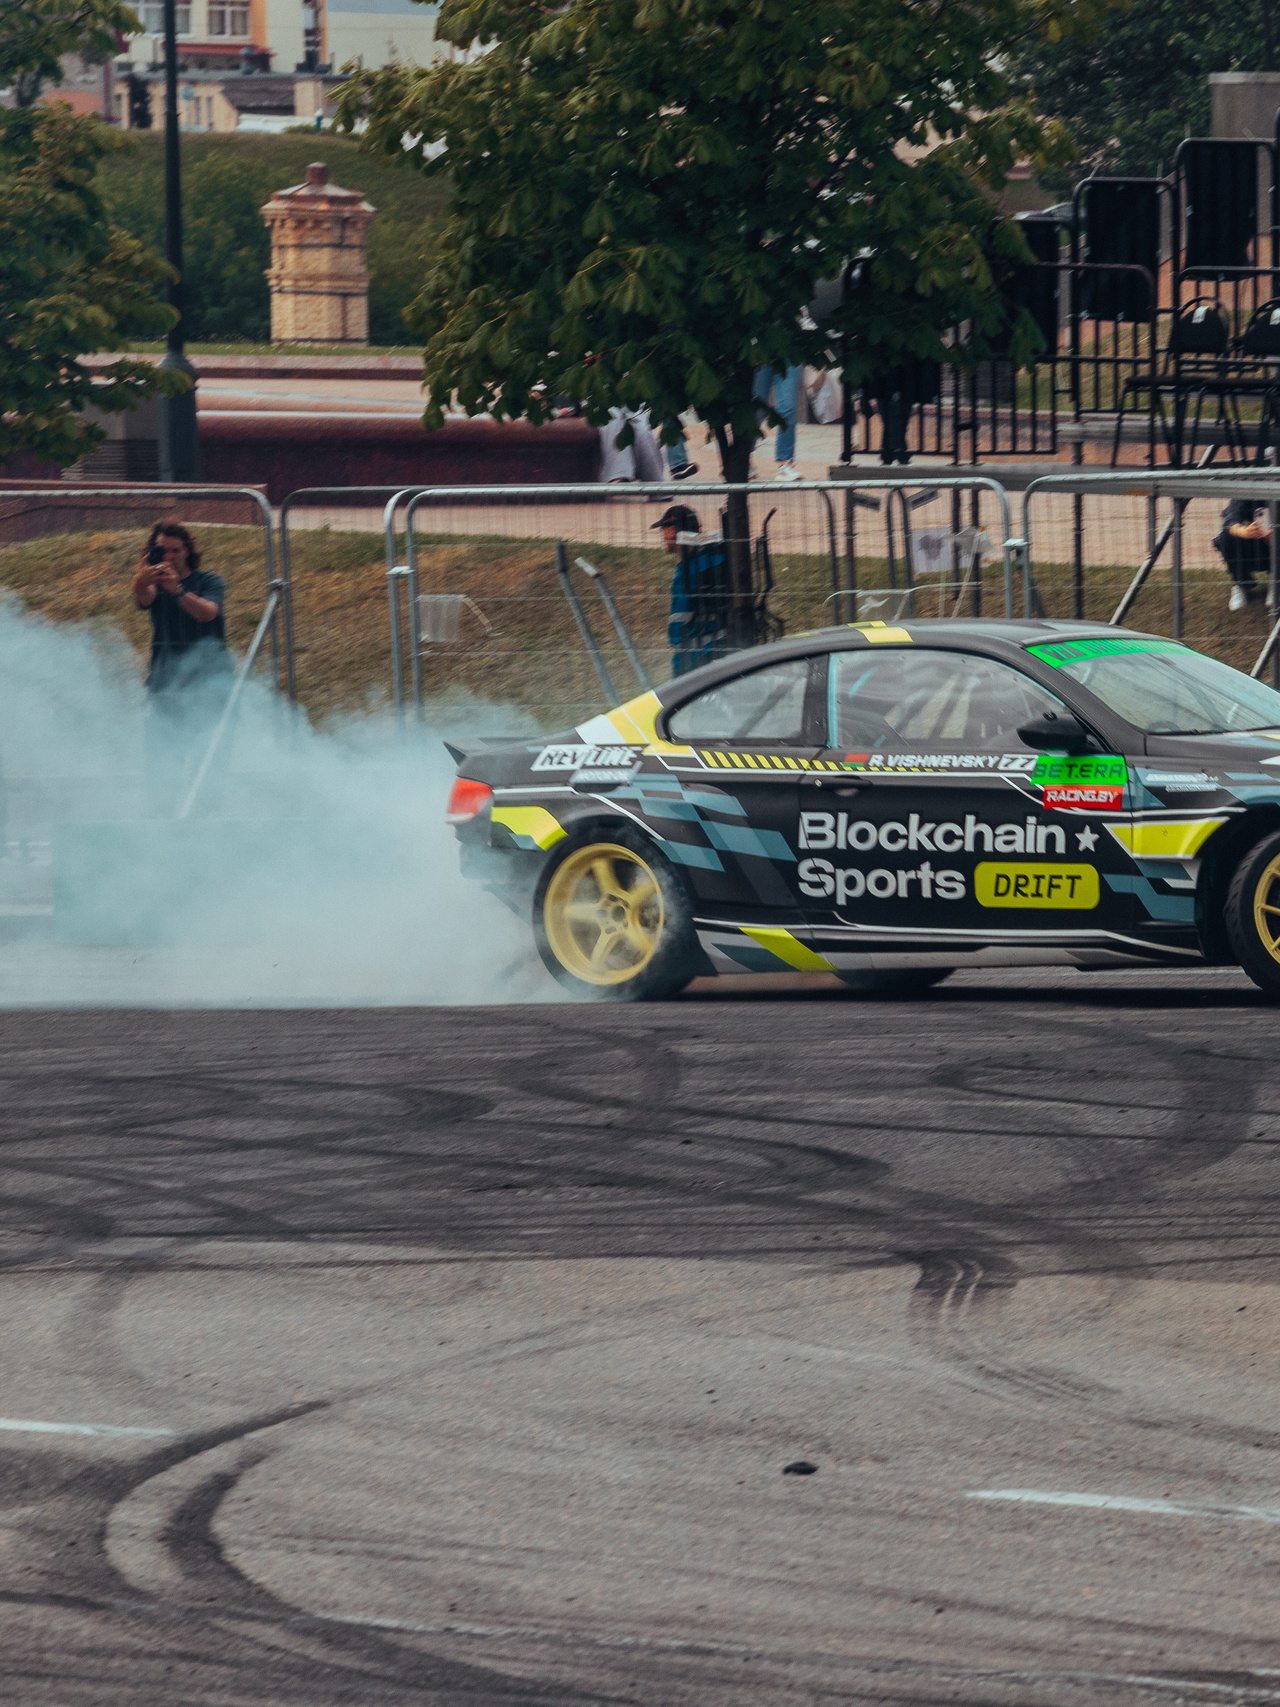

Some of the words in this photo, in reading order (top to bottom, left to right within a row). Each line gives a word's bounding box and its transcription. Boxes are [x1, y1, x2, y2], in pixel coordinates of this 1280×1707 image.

[1047, 789, 1119, 803] RACING.BY
[798, 811, 1067, 854] Blockchain
[797, 857, 967, 906] Sports
[993, 873, 1083, 899] DRIFT
